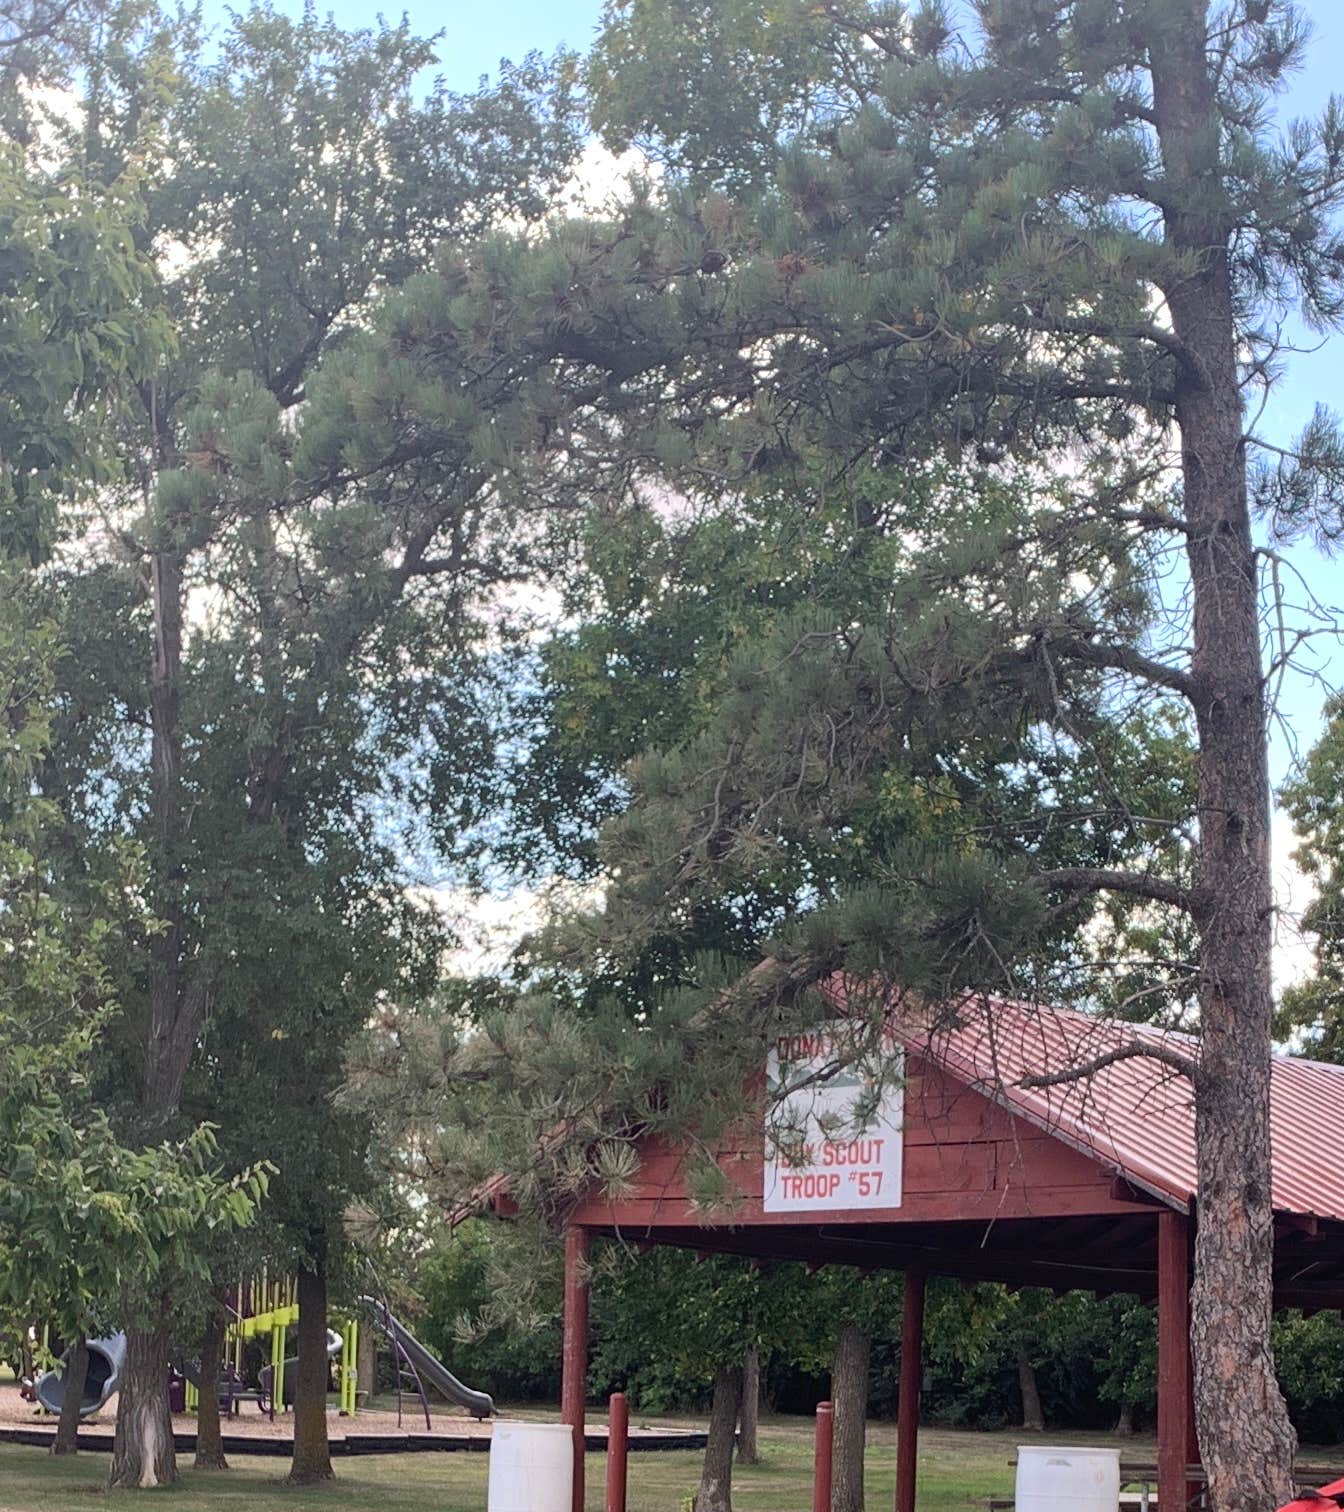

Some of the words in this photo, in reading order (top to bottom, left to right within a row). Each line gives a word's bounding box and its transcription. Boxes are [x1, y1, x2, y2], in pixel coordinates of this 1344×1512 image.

[823, 1139, 884, 1166] SCOUT
[781, 1173, 840, 1199] TROOP
[848, 1171, 883, 1197] #57
